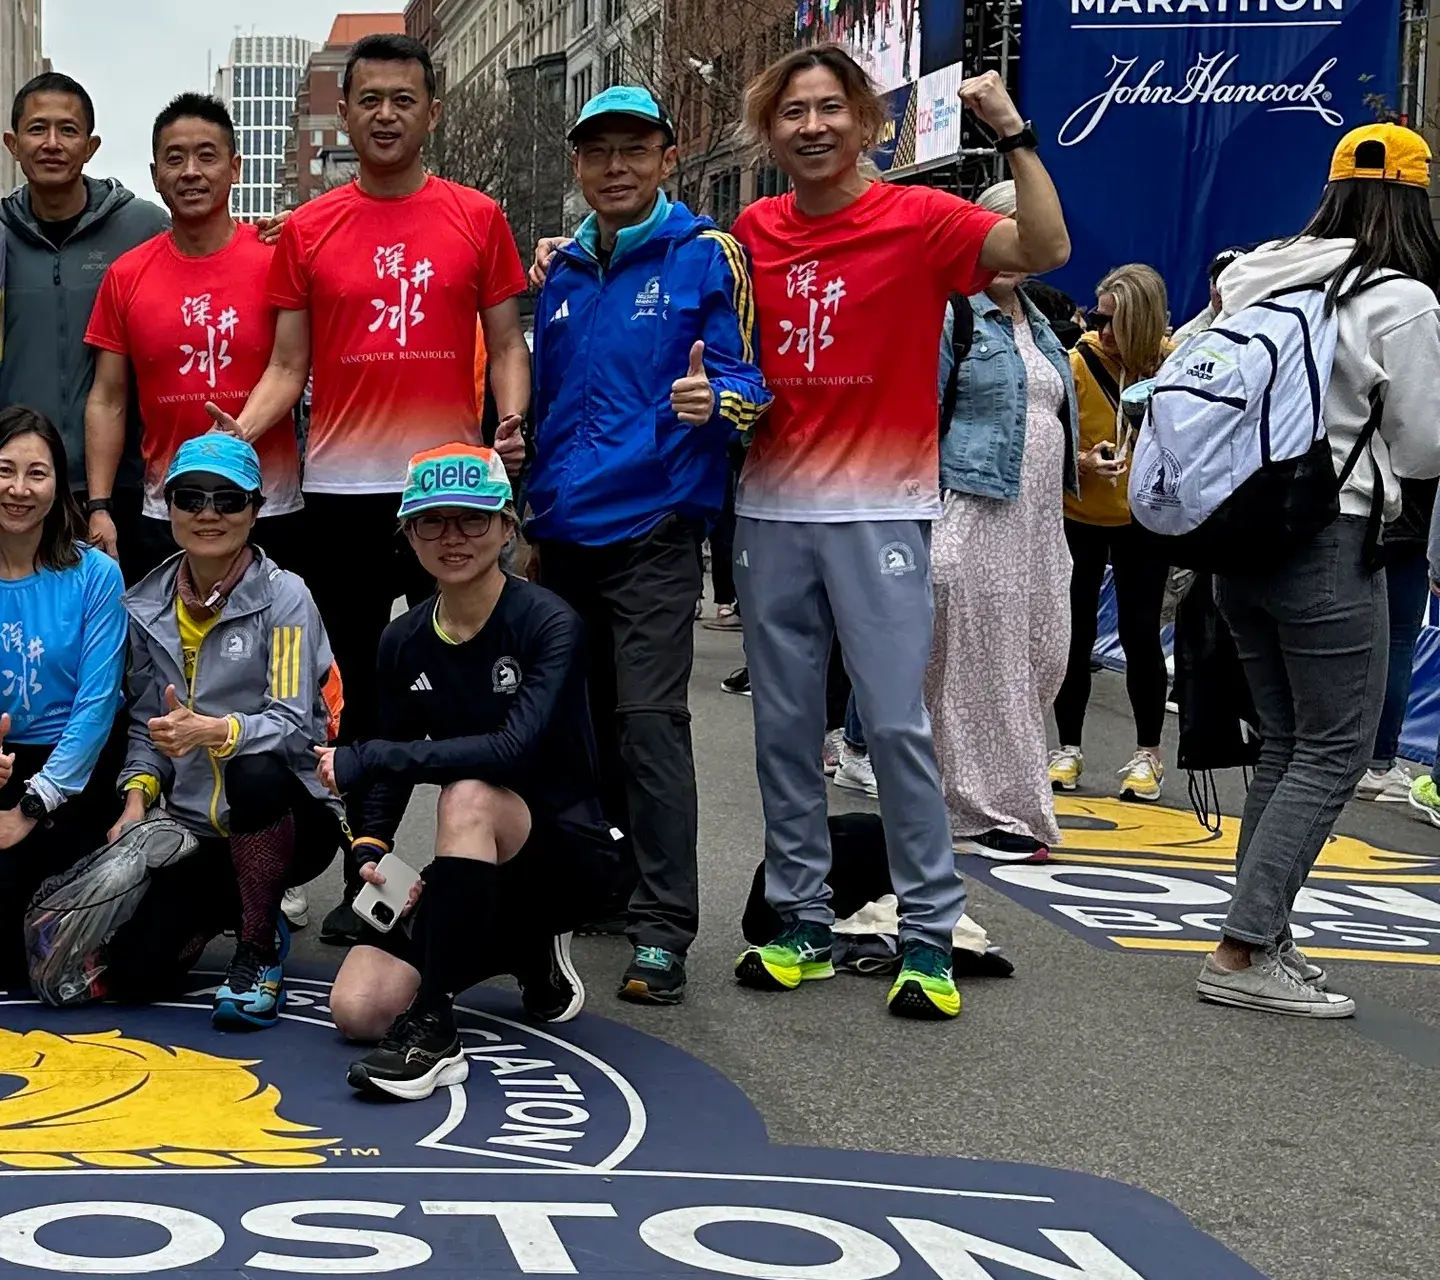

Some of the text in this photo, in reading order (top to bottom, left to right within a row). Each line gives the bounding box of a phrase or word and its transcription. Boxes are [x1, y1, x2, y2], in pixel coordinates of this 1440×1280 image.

[1058, 54, 1173, 147] John
[1171, 50, 1344, 127] Hancock
[340, 351, 394, 364] VANCOUVER
[807, 375, 874, 386] RUNAHOLICS
[421, 460, 481, 493] ciele
[327, 1146, 381, 1157] TM
